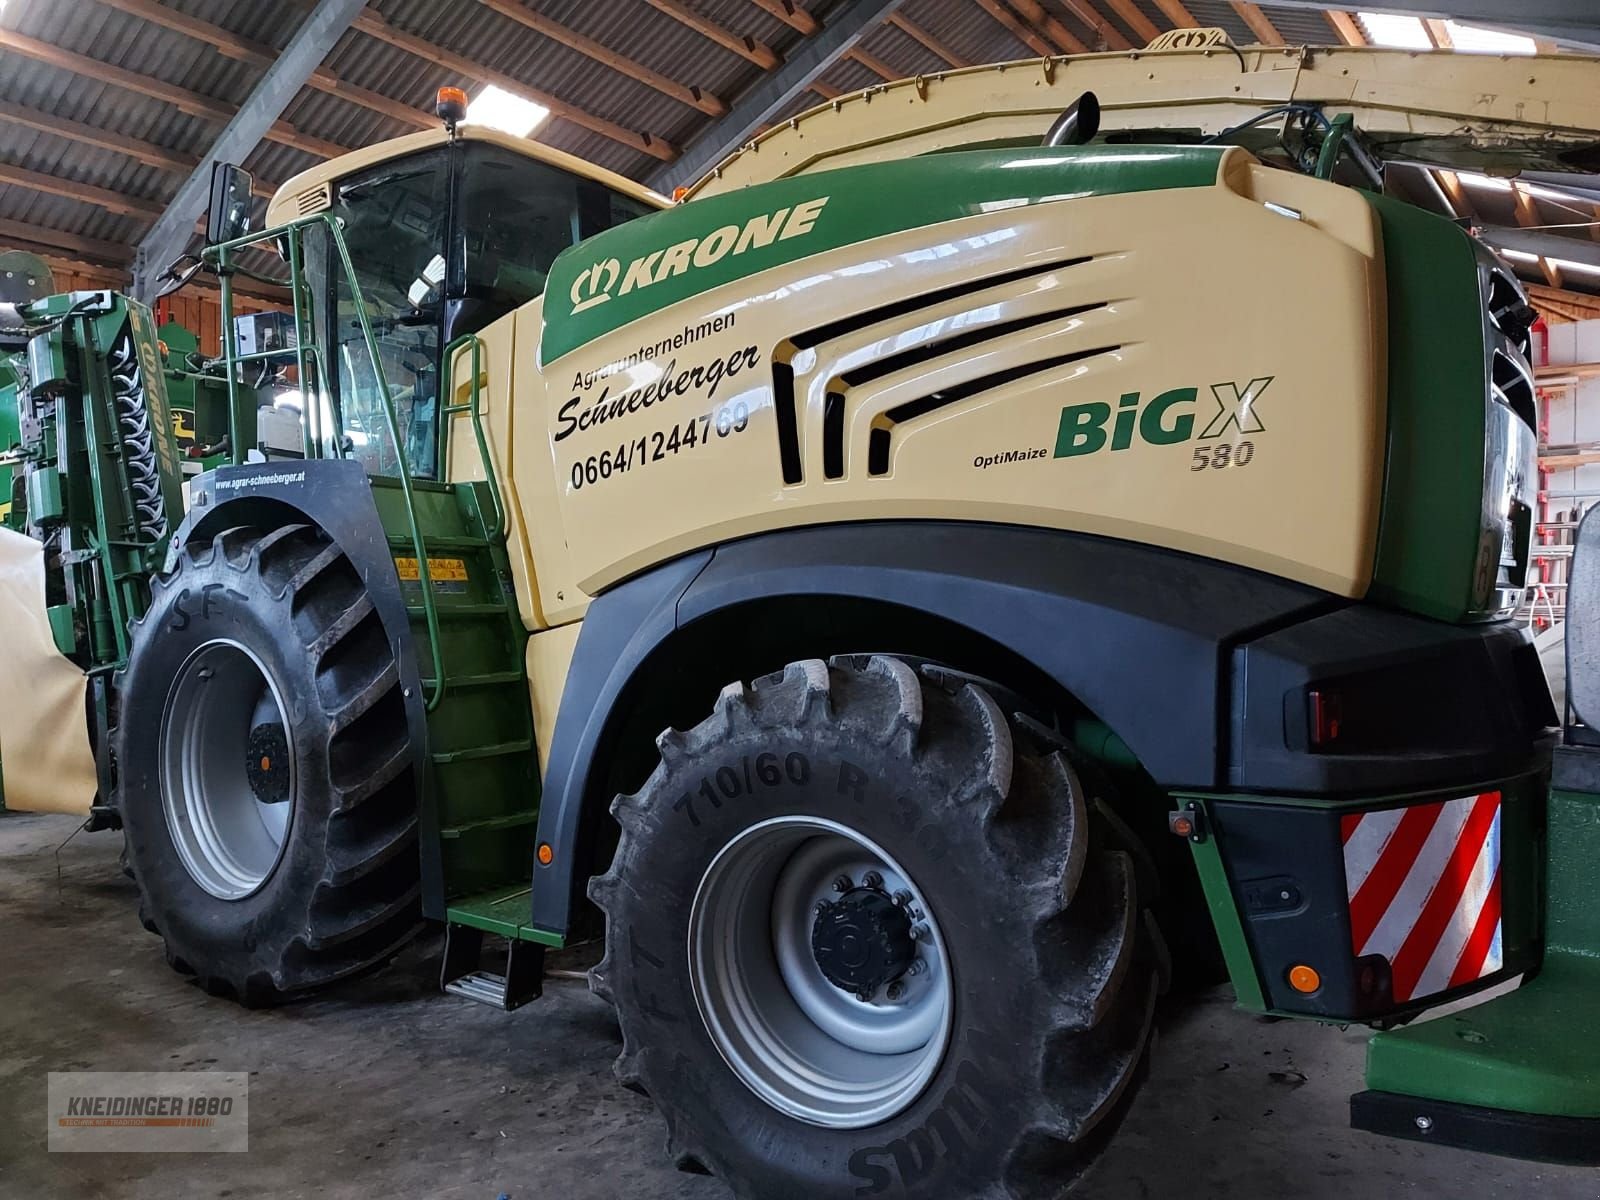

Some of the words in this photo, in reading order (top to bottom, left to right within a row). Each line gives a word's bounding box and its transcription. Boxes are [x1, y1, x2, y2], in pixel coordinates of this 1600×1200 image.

[617, 196, 831, 297] KRONE
[572, 311, 736, 391] Agrarunternehmen
[554, 345, 761, 442] Schneeberger
[215, 471, 305, 490] www.agrar-schneeberger.at
[571, 401, 750, 490] 0664/1244769
[973, 447, 1048, 470] OptiMaize
[1190, 440, 1255, 472] 580
[672, 751, 812, 828] 710/60
[836, 759, 870, 803] R
